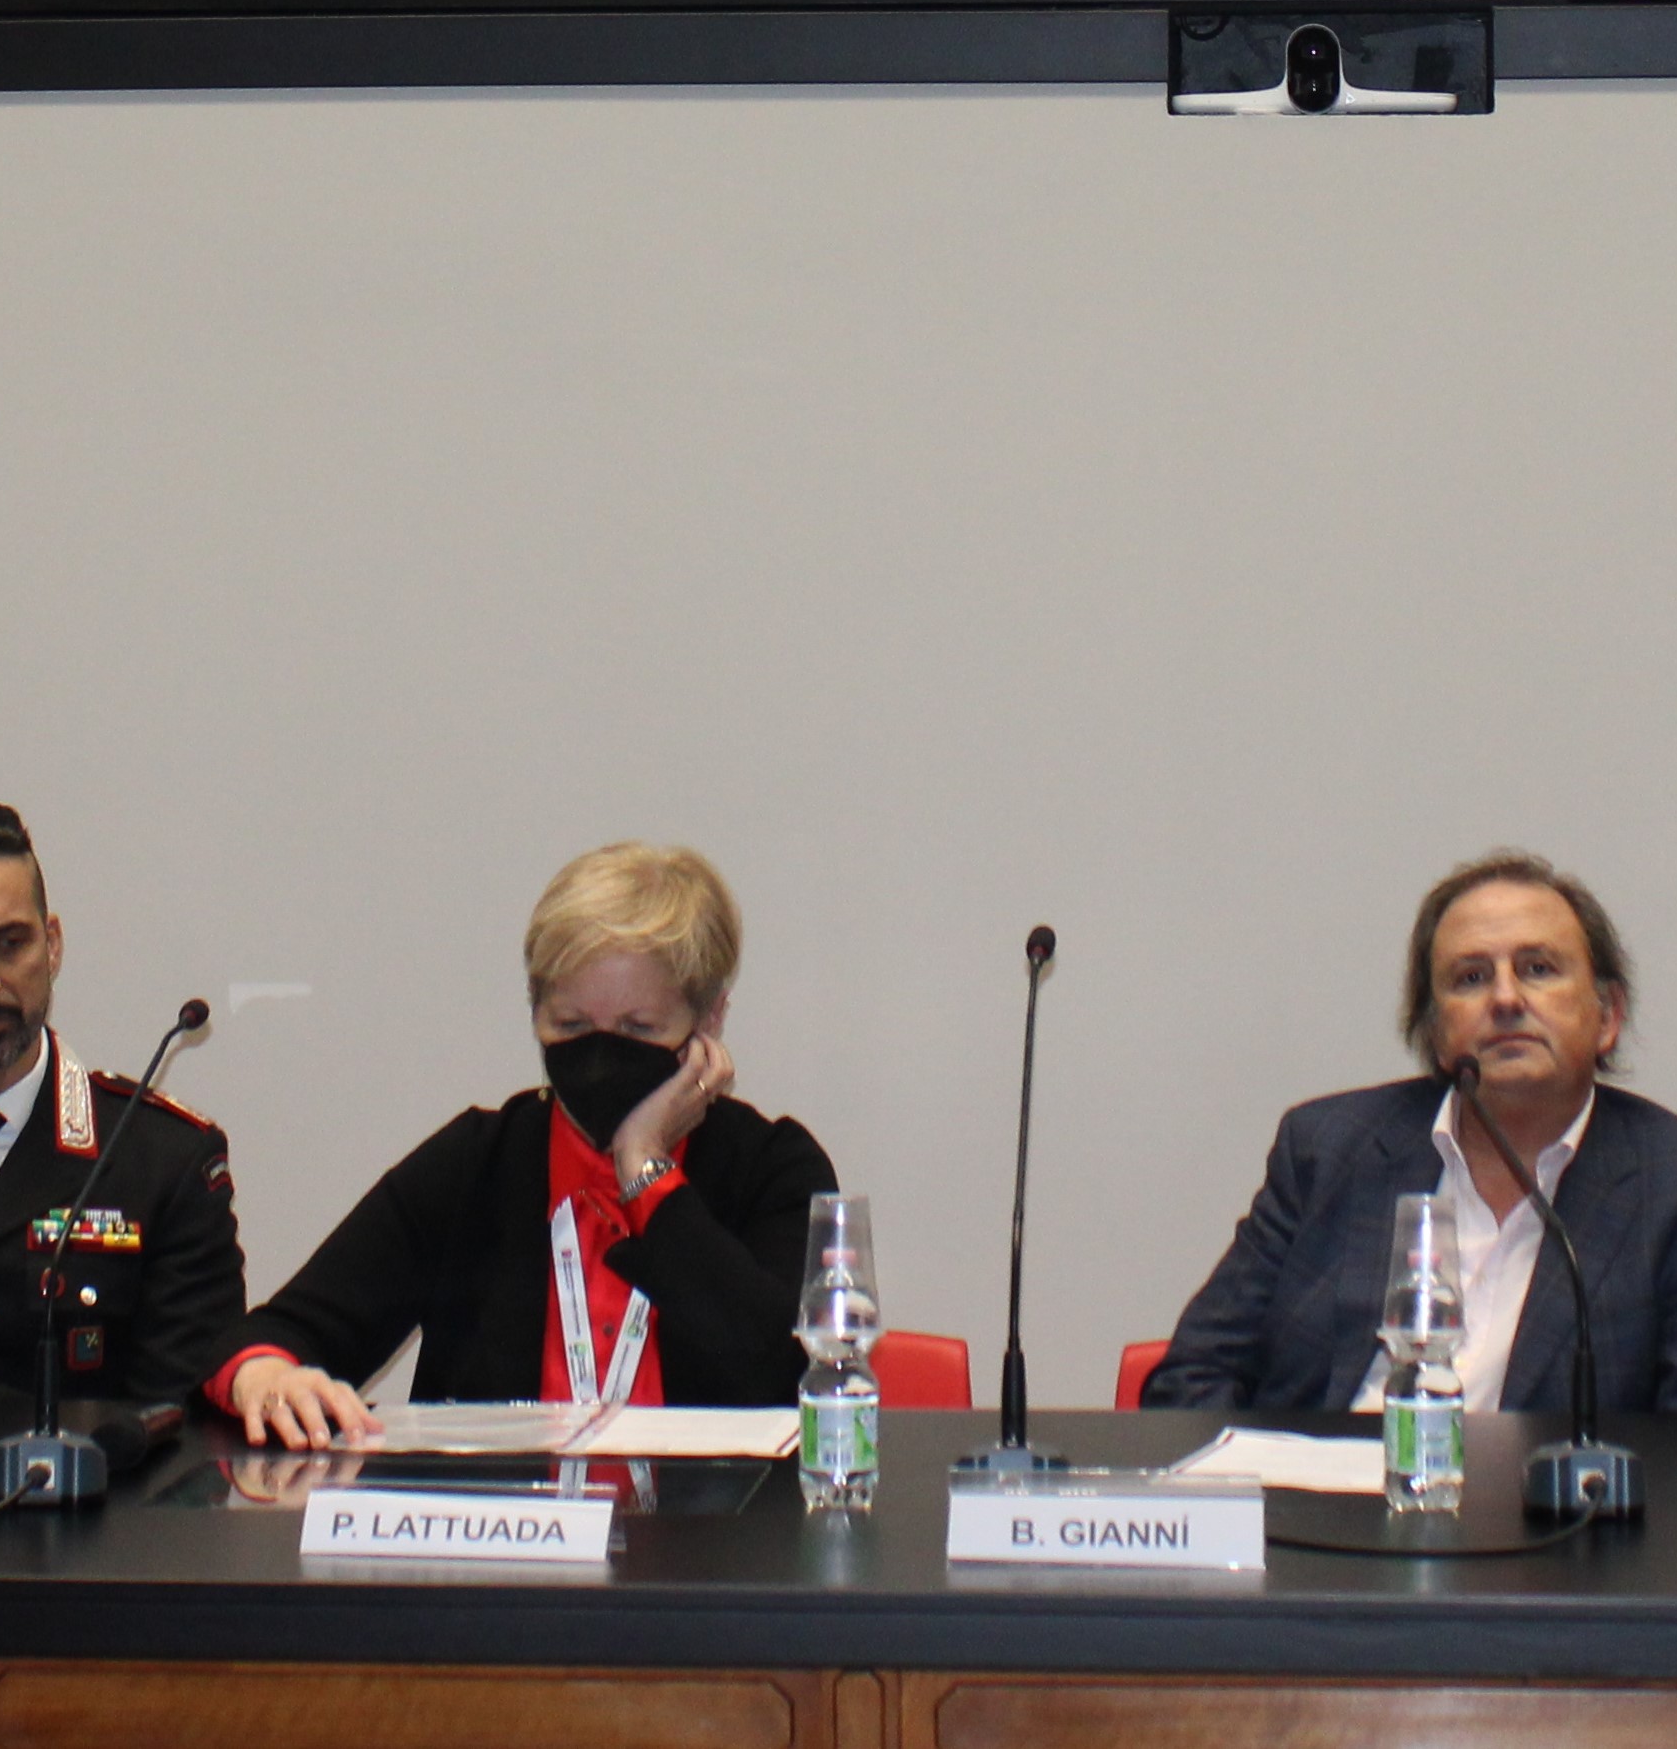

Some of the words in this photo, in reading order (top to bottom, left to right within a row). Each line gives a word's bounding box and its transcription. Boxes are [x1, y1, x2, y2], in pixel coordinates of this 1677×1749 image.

[331, 1513, 357, 1538] P.
[372, 1514, 567, 1543] LATTUADA
[1011, 1519, 1045, 1546] B.
